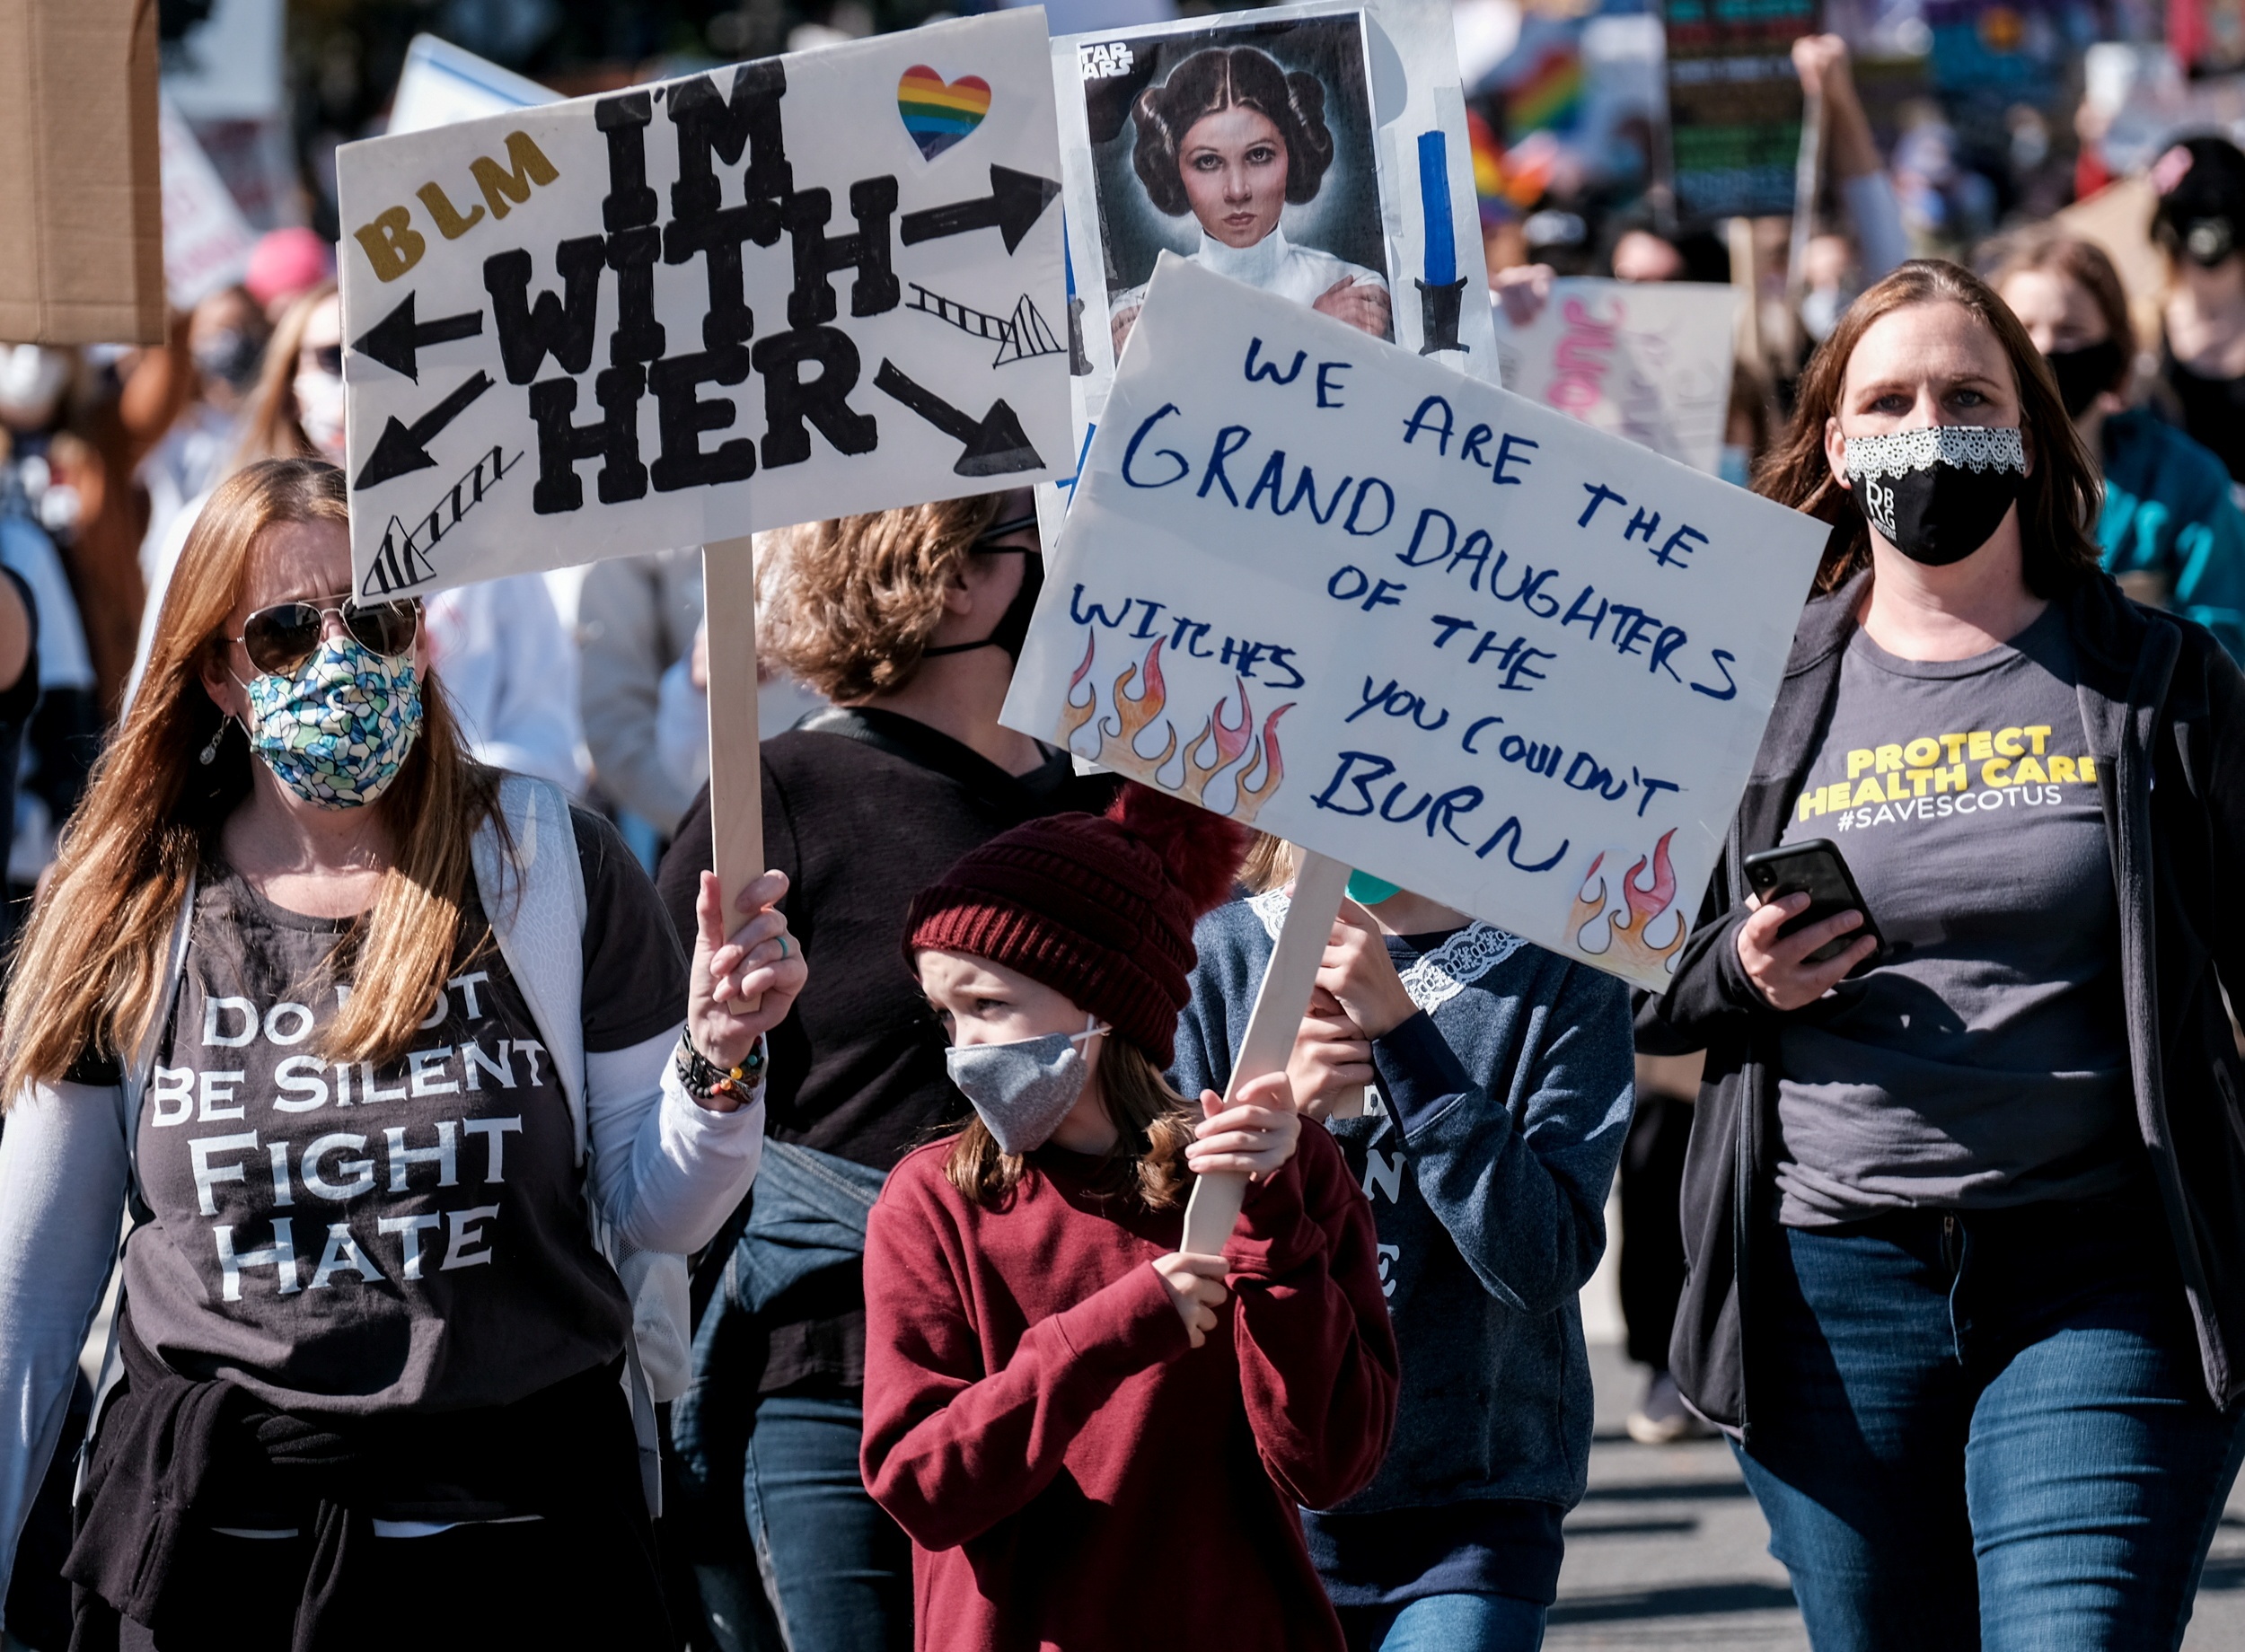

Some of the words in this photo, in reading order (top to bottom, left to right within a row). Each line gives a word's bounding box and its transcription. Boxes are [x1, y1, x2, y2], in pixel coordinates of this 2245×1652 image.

[1078, 41, 1133, 65] TAR
[1082, 57, 1134, 81] ARS
[594, 57, 794, 233] I'M
[354, 130, 560, 283] BLM
[482, 174, 901, 386] WITH
[528, 325, 877, 515] HER
[1244, 337, 1353, 409] WE
[1402, 393, 1540, 486] ARE
[1576, 481, 1710, 570] THE
[1069, 583, 1307, 690] WITCHES
[1326, 564, 1408, 613] OF
[1431, 613, 1558, 692] THE
[1798, 762, 1968, 822] HEALTH
[1846, 725, 2052, 780] PROTECT
[1308, 750, 1571, 874] BURN
[1836, 784, 2063, 833] #SAVESCOTUS
[151, 1064, 246, 1128] BE
[272, 1038, 546, 1113] SILENT
[187, 1113, 523, 1217] FIGHT
[212, 1203, 501, 1302] HATE
